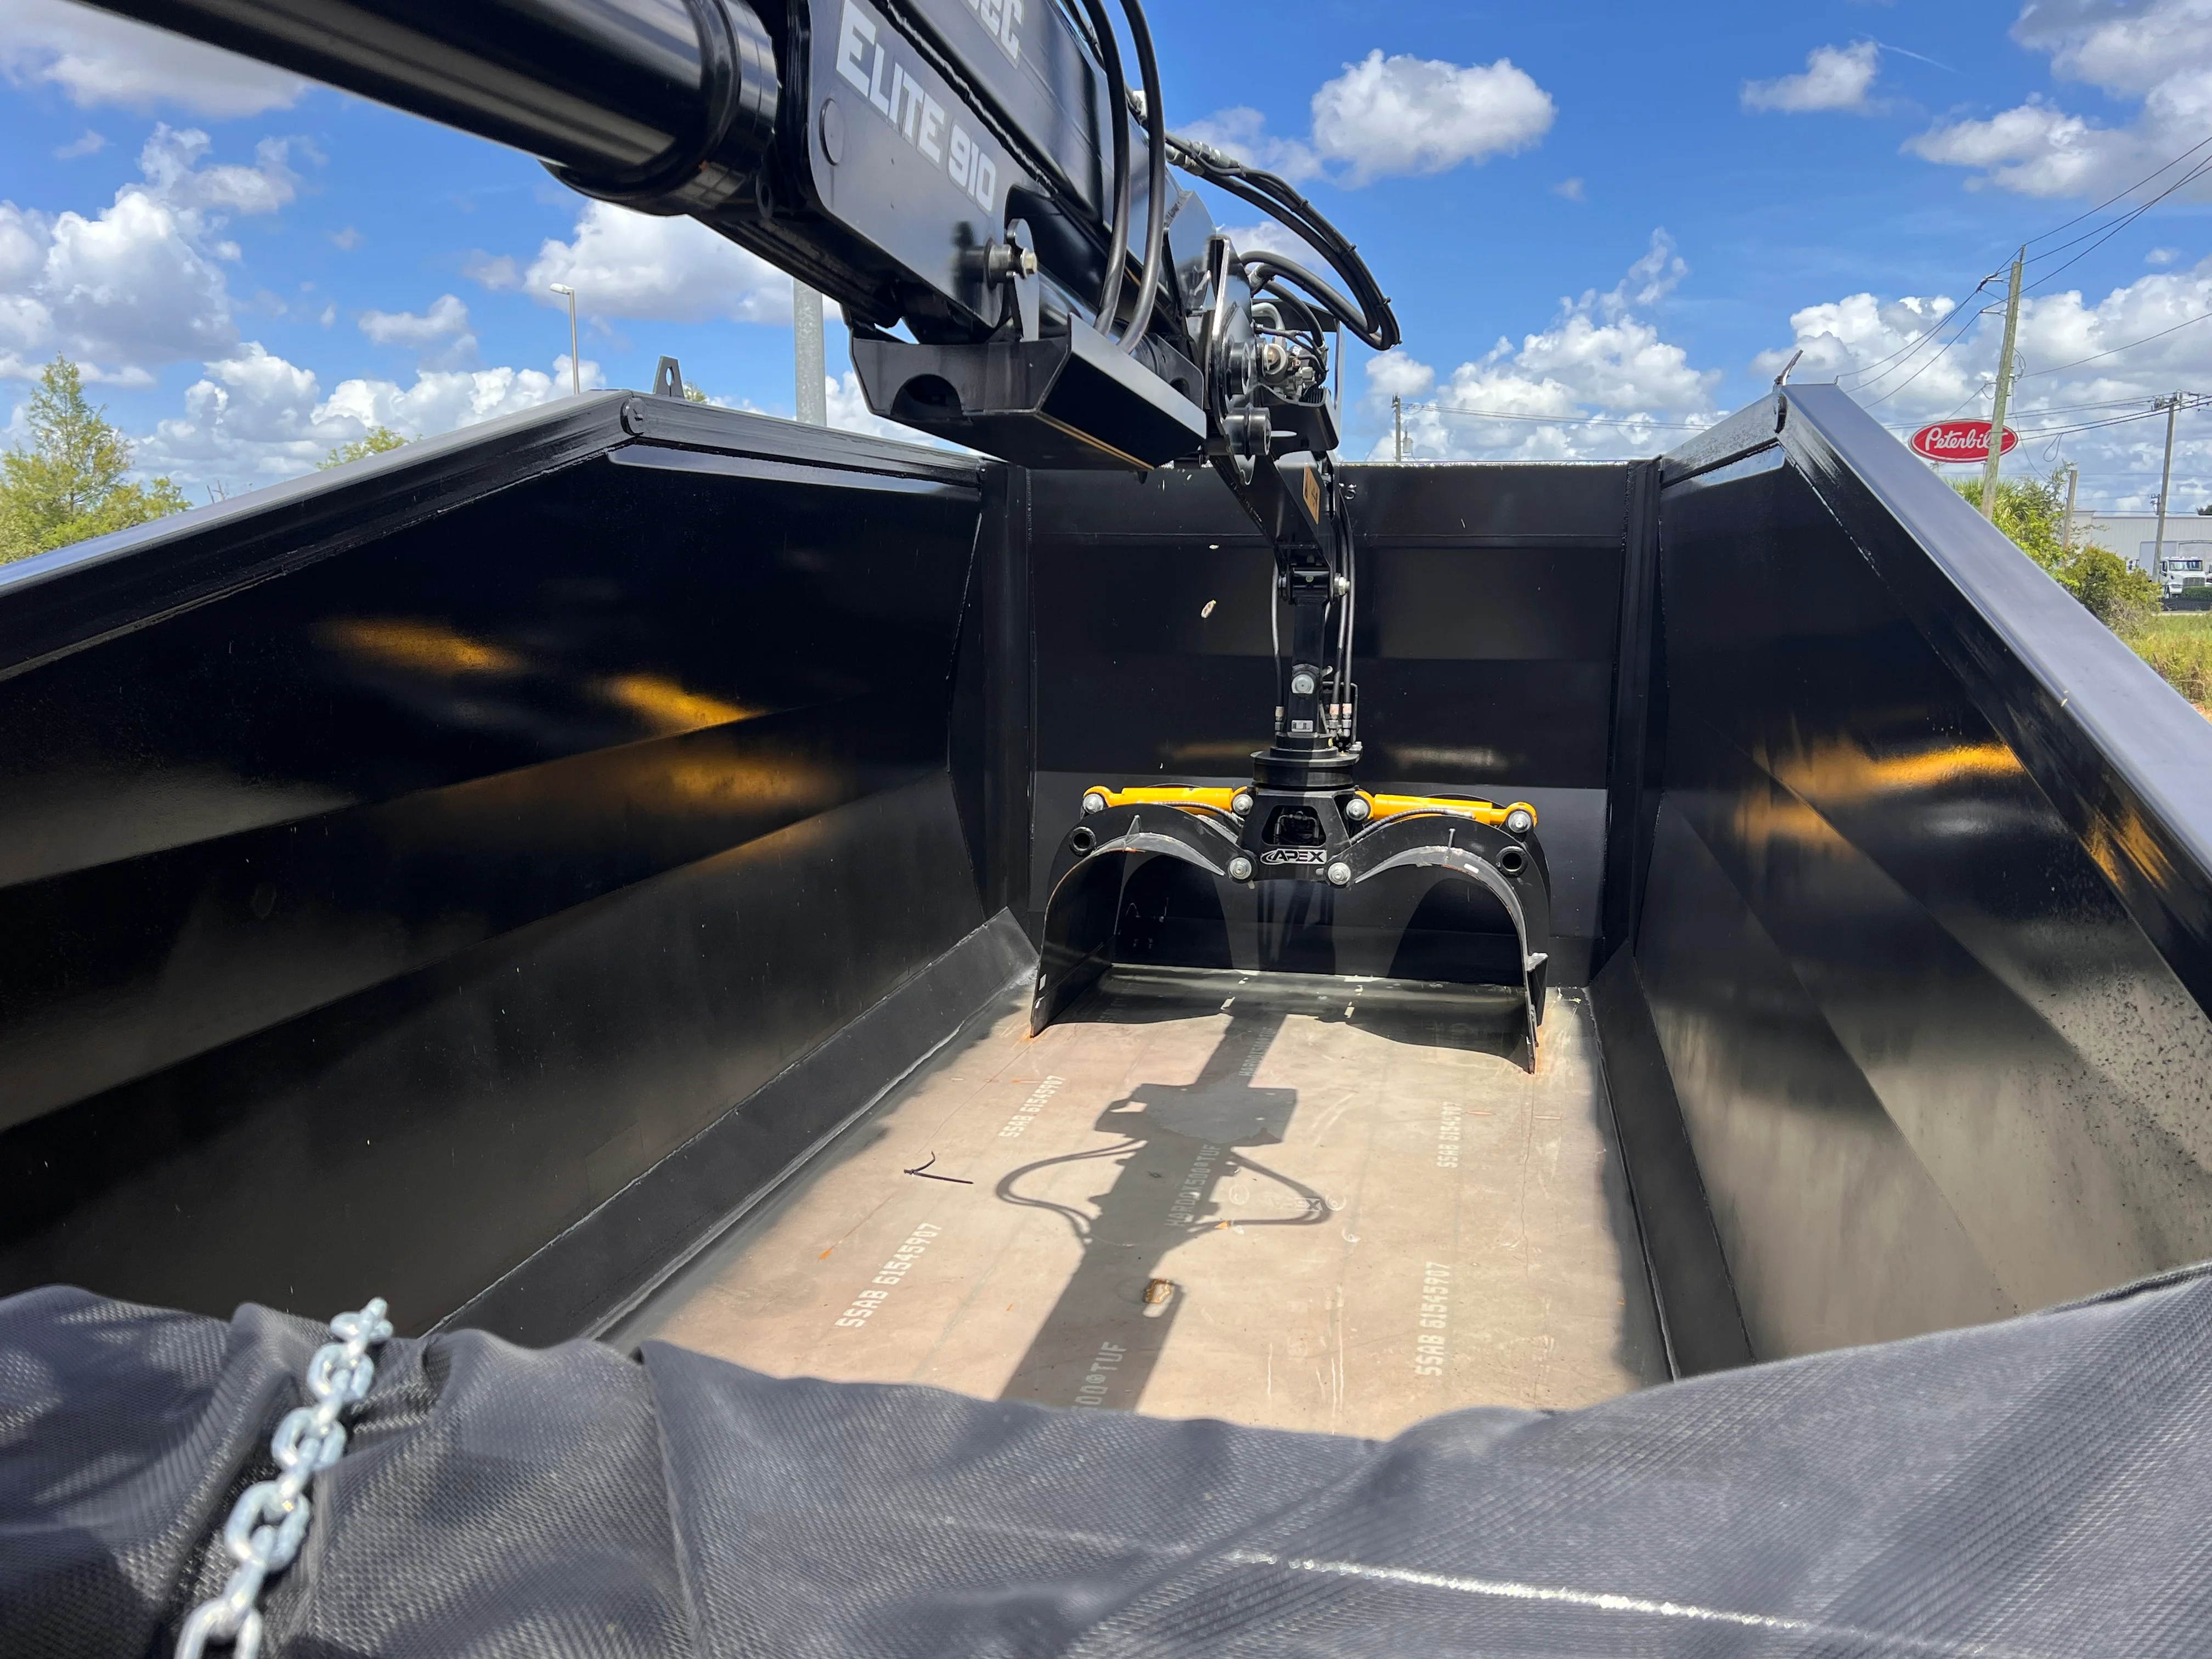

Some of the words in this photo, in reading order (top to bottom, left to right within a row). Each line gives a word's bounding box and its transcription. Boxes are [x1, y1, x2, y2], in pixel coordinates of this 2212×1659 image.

[836, 0, 945, 163] ELITE
[948, 123, 996, 212] 910
[1925, 427, 2008, 451] Peterbil
[1266, 849, 1324, 862] APEX
[998, 1115, 1034, 1137] SSAB
[1436, 1144, 1459, 1168] SSAB
[834, 1290, 889, 1328] SSAB
[871, 1222, 942, 1285] 61545907
[1419, 1261, 1452, 1328] 61545907
[1414, 1334, 1445, 1376] SSAB
